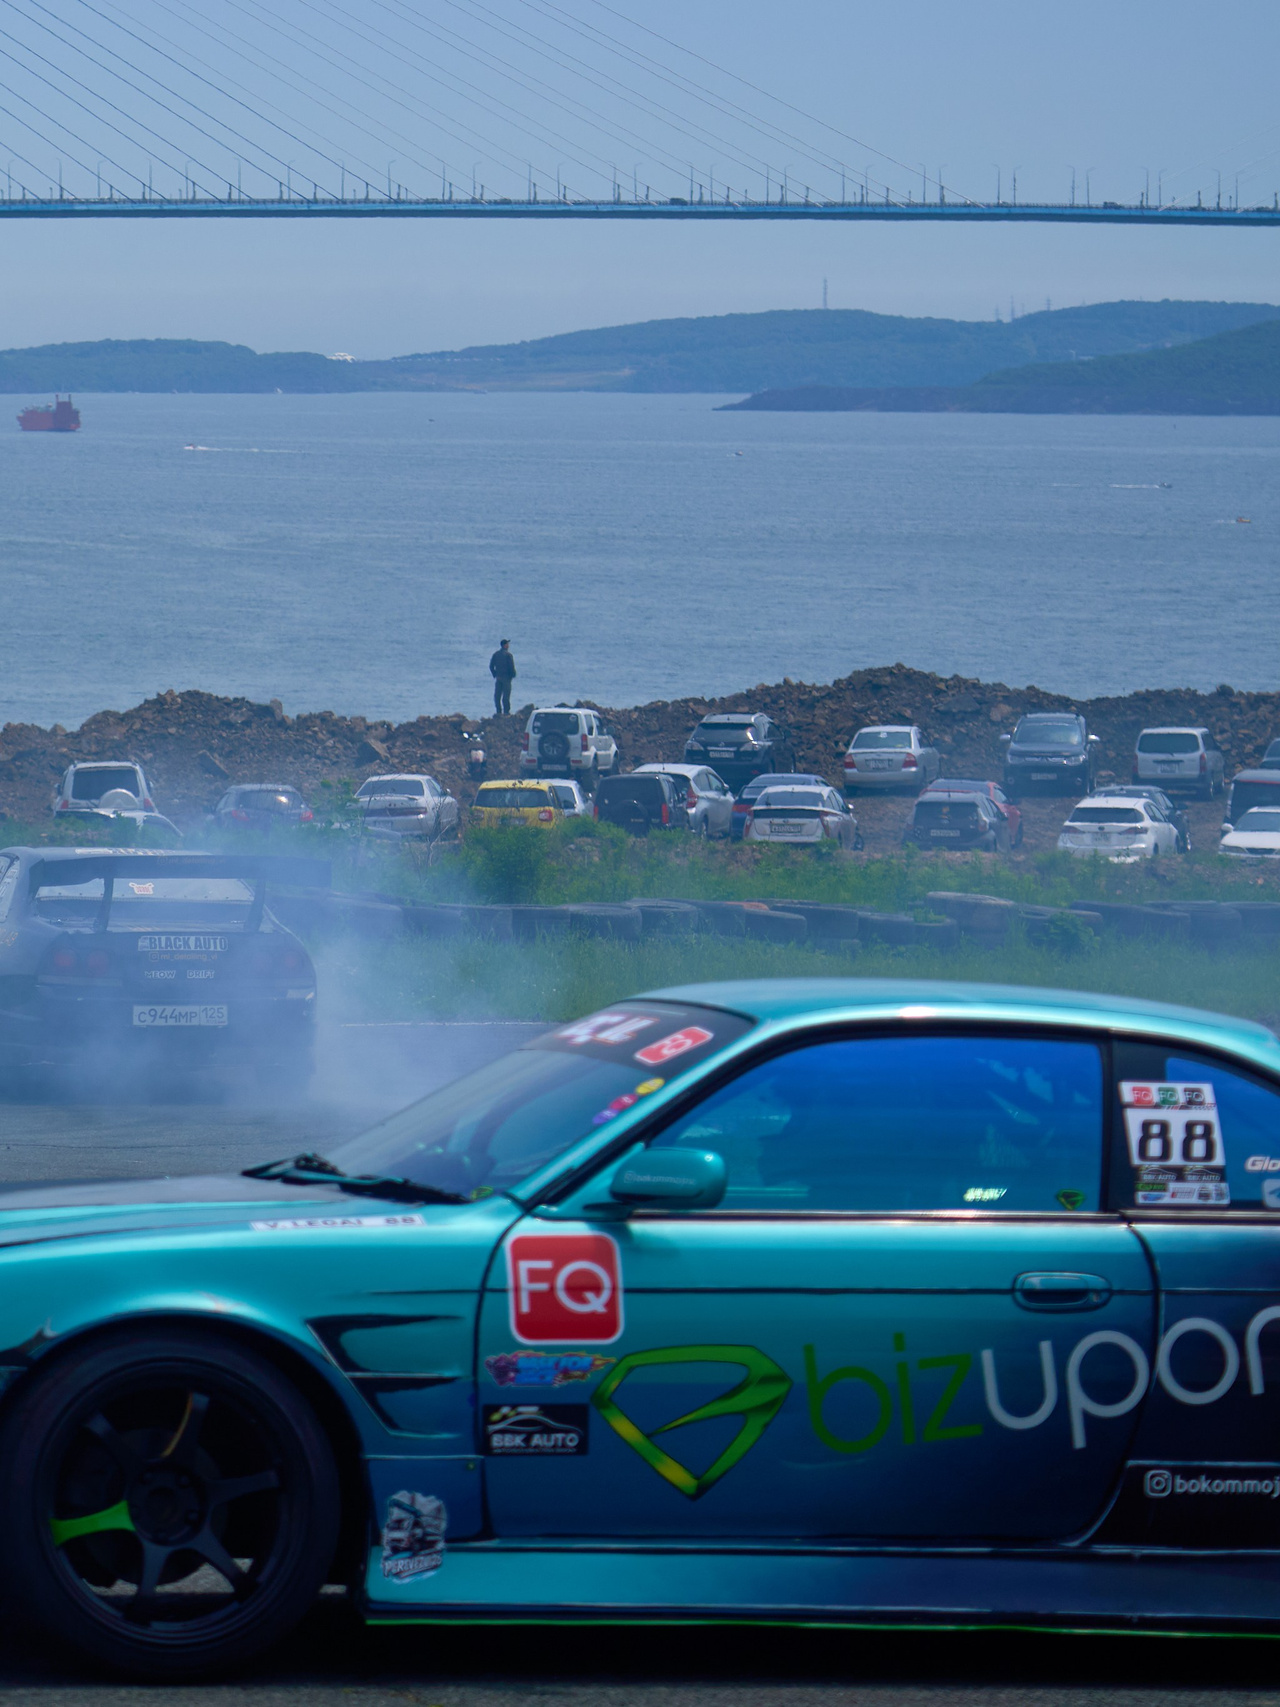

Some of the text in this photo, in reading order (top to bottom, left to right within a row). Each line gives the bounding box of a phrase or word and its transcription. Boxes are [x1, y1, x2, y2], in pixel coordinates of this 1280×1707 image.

[149, 936, 191, 950] BLACK
[194, 937, 227, 951] AUTO
[145, 970, 215, 979] MEOW DRIFT
[201, 1007, 224, 1019] 125
[1138, 1119, 1216, 1163] 88
[384, 1216, 415, 1225] 88
[517, 1260, 613, 1314] FQ
[491, 1433, 579, 1448] BBK AUTO
[1174, 1474, 1280, 1499] bokommoj
